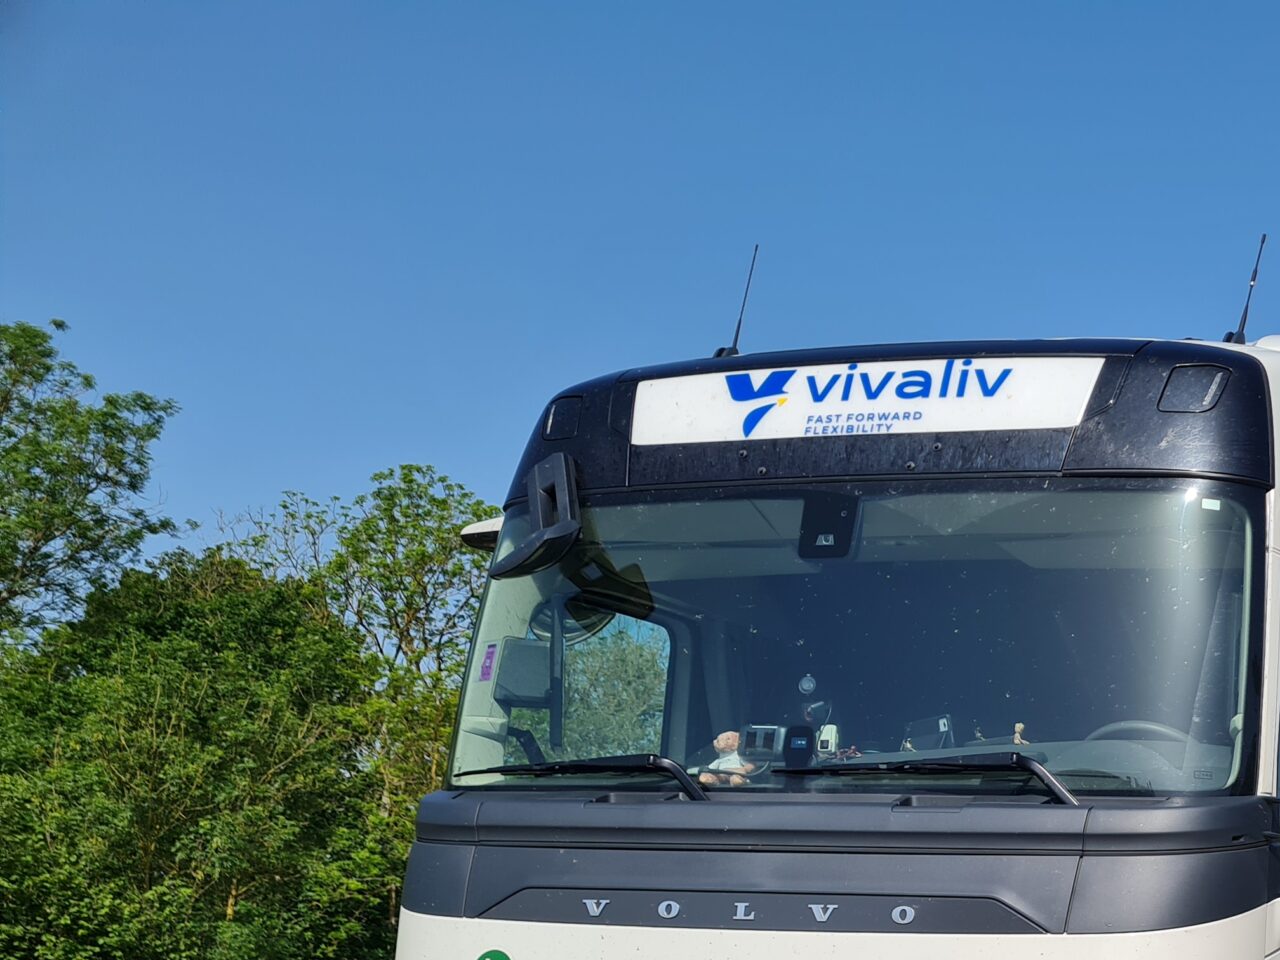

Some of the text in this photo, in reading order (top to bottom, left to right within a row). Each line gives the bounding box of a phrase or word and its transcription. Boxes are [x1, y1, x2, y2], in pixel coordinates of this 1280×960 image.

[806, 359, 1013, 403] vivaliv
[806, 411, 923, 425] FAST FORWARD
[804, 423, 894, 435] FLEXIBILITY
[582, 899, 916, 924] VOLVO
